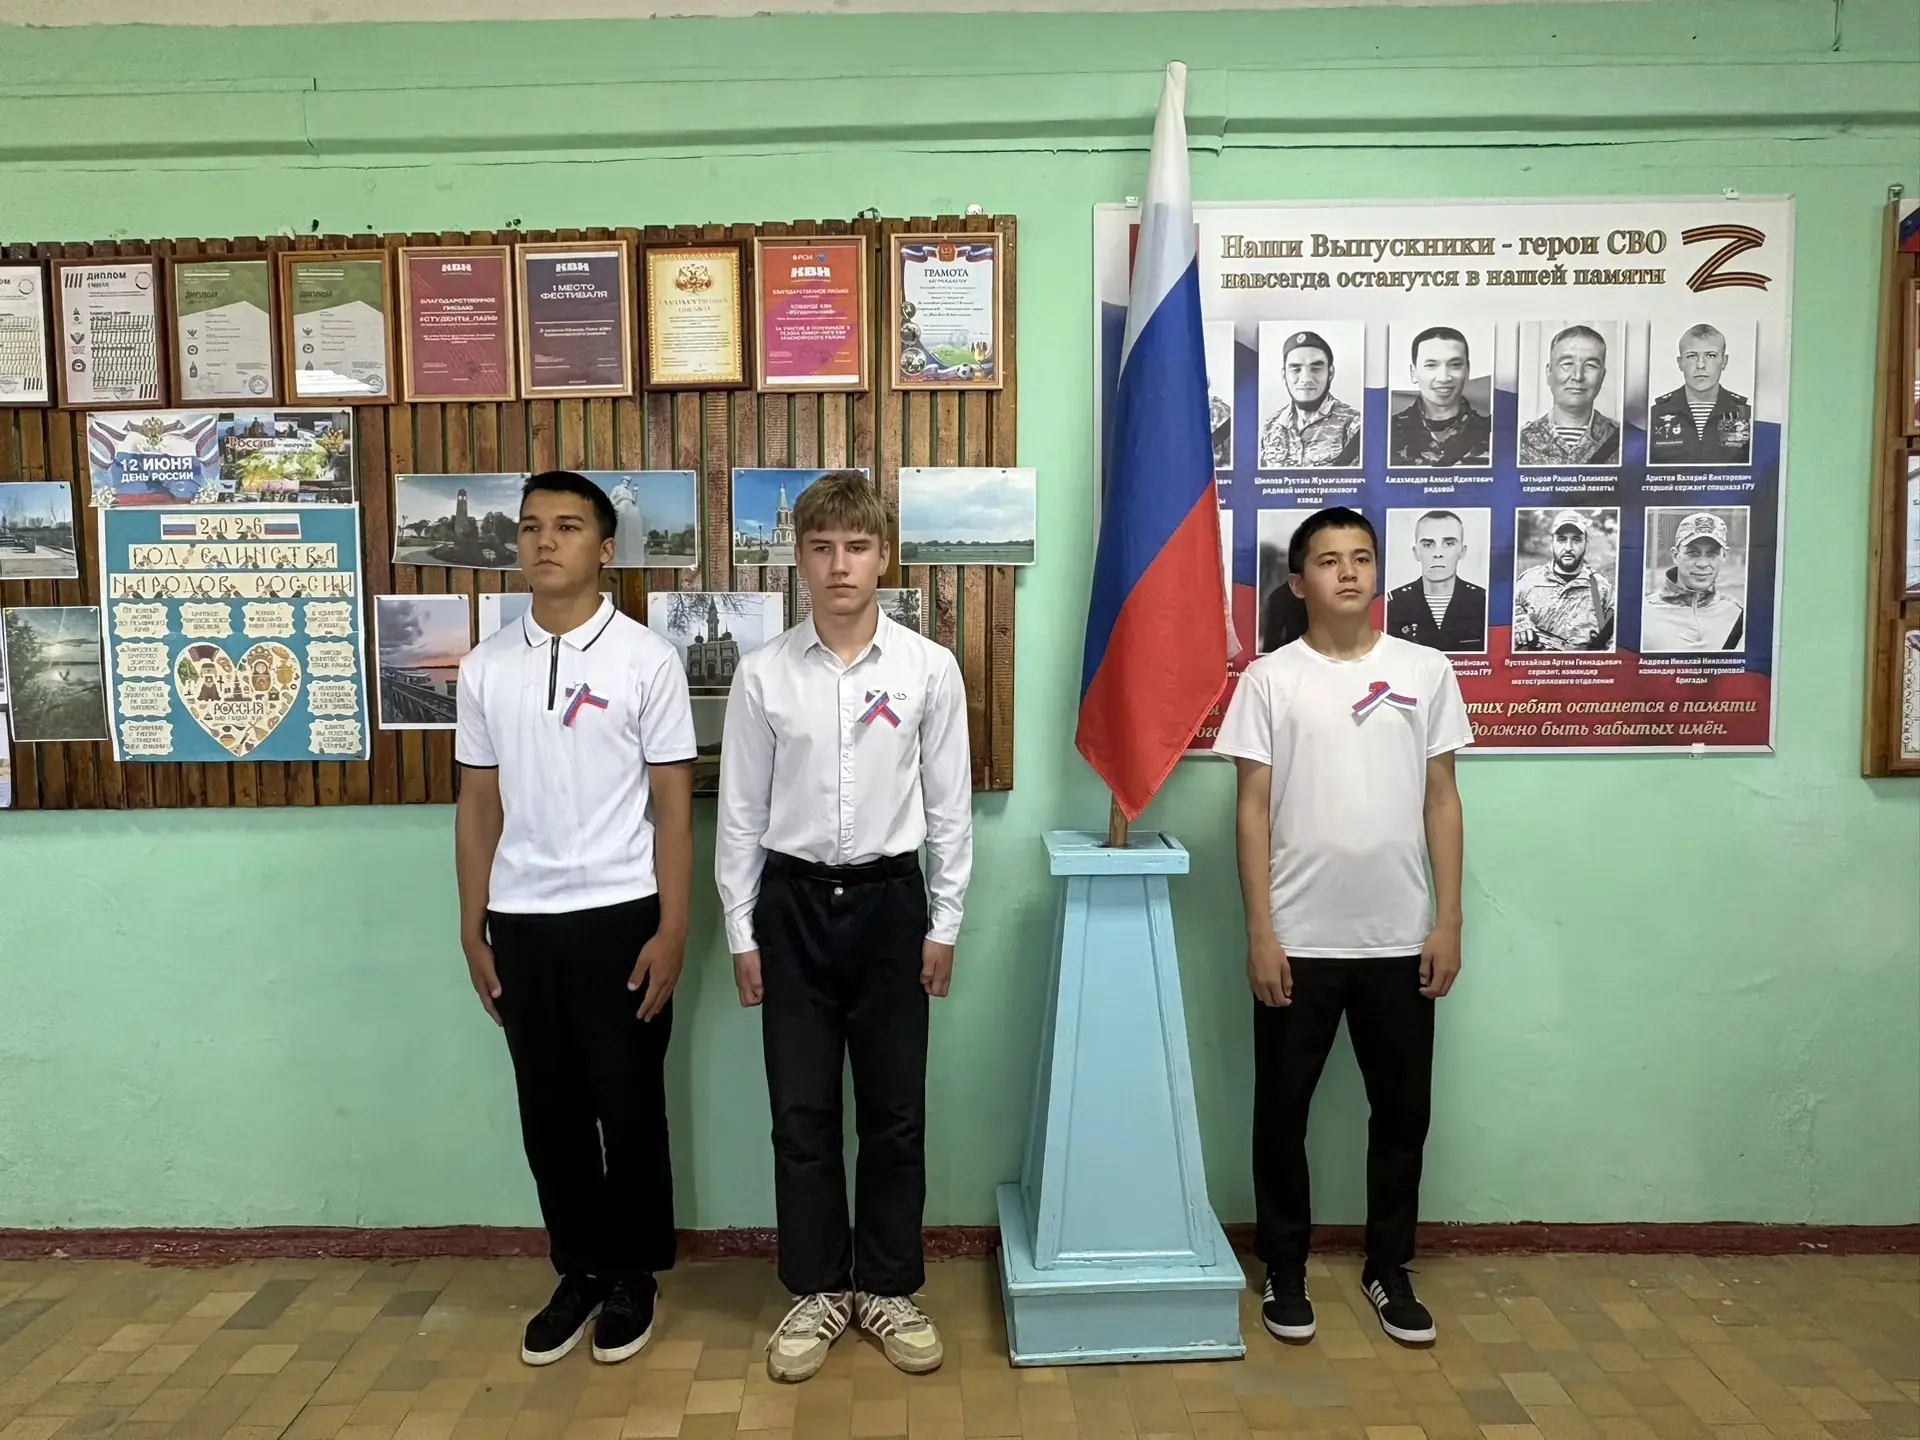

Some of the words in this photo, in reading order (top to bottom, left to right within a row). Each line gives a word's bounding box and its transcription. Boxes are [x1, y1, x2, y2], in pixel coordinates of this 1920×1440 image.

[1221, 234, 1304, 258] Наши
[1310, 234, 1495, 263] Выпускники
[1519, 236, 1601, 261] герои
[1606, 230, 1668, 255] СВО
[442, 263, 472, 272] КВН
[555, 262, 590, 272] КВН
[790, 266, 831, 278] КВН
[924, 268, 969, 277] ГРАМОТА
[86, 272, 127, 281] ДИПЛОМ
[1221, 272, 1331, 291] навсегда
[1336, 270, 1459, 292] останутся
[1466, 269, 1481, 286] в
[1486, 264, 1568, 286] нашей
[1573, 268, 1667, 286] памяти
[540, 291, 608, 299] ФЕСТИВАЛЯ
[120, 458, 139, 471] 12
[142, 457, 193, 471] ИЮНЯ
[120, 472, 150, 483] ДЕНЬ
[151, 472, 194, 481] РОССИИ
[1283, 476, 1310, 486] Рустам
[1423, 485, 1455, 494] рядовой
[1641, 484, 1674, 492] старший
[1674, 484, 1706, 492] сержант
[1741, 482, 1756, 491] ГРУ
[132, 547, 180, 566] ГОД
[255, 574, 353, 593] РОССИИ
[1479, 668, 1493, 676] ГРУ
[213, 702, 264, 715] РОССИЯ
[1506, 699, 1562, 717] ребят
[1566, 701, 1665, 714] останется
[1668, 701, 1679, 713] в
[1683, 700, 1757, 713] памяти
[1471, 721, 1538, 736] должно
[1541, 721, 1590, 736] быть
[1592, 720, 1675, 736] забытых
[1678, 719, 1729, 736] имён.
